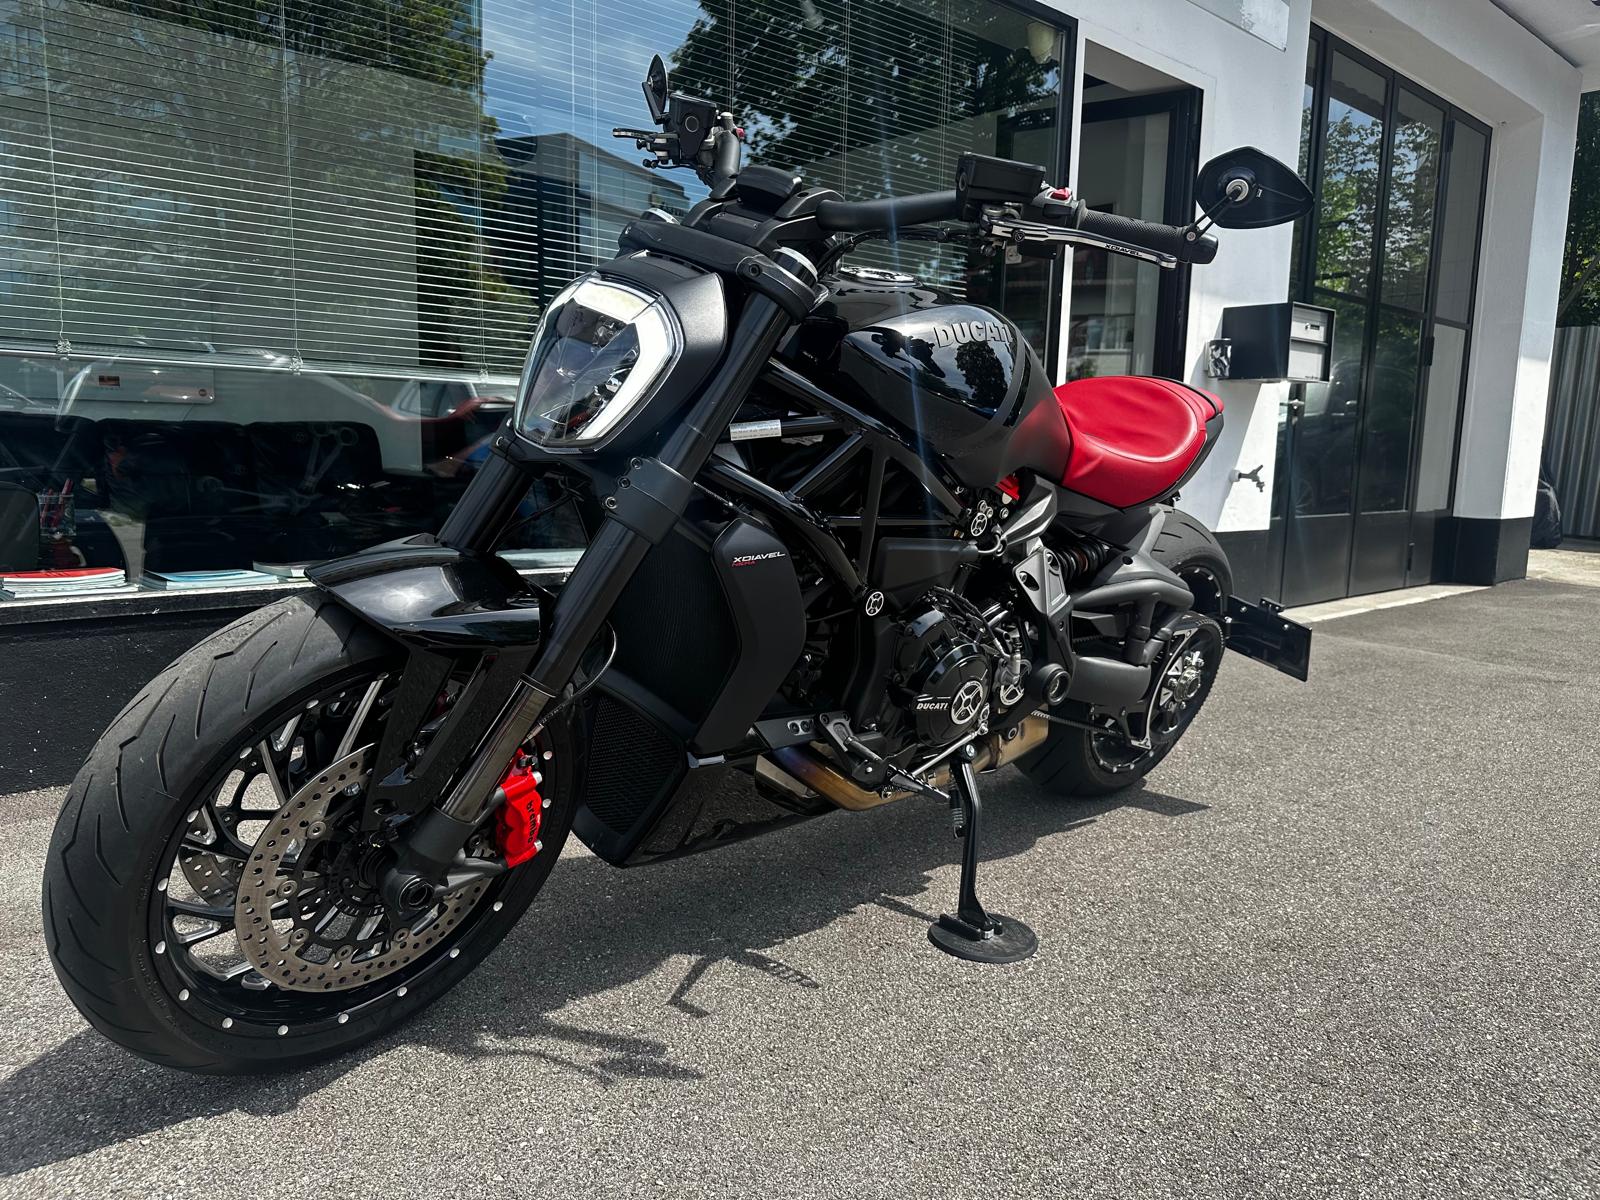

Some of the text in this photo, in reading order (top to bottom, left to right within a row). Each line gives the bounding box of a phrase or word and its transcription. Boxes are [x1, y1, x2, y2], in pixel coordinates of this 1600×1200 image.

[933, 320, 1013, 348] DUCATI
[733, 551, 786, 563] XDIAVEL
[916, 702, 949, 710] DUCATI
[526, 800, 537, 844] brembo
